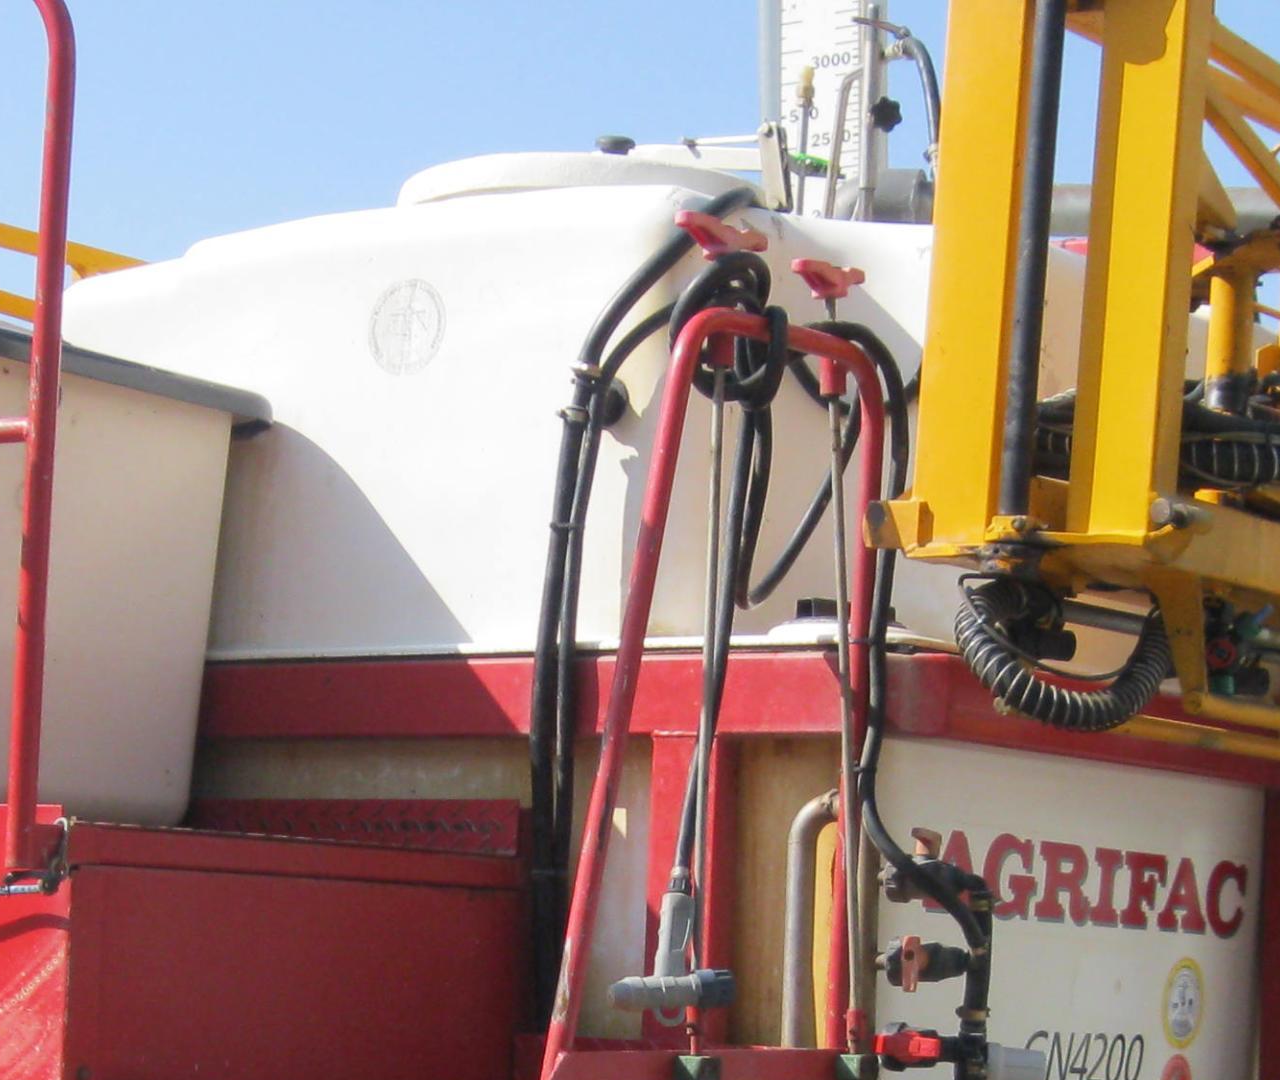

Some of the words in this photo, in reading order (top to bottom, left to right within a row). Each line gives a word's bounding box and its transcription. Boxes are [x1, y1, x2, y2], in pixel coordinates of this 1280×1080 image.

[811, 51, 851, 70] 3000
[789, 106, 819, 123] 50
[811, 129, 851, 147] 250
